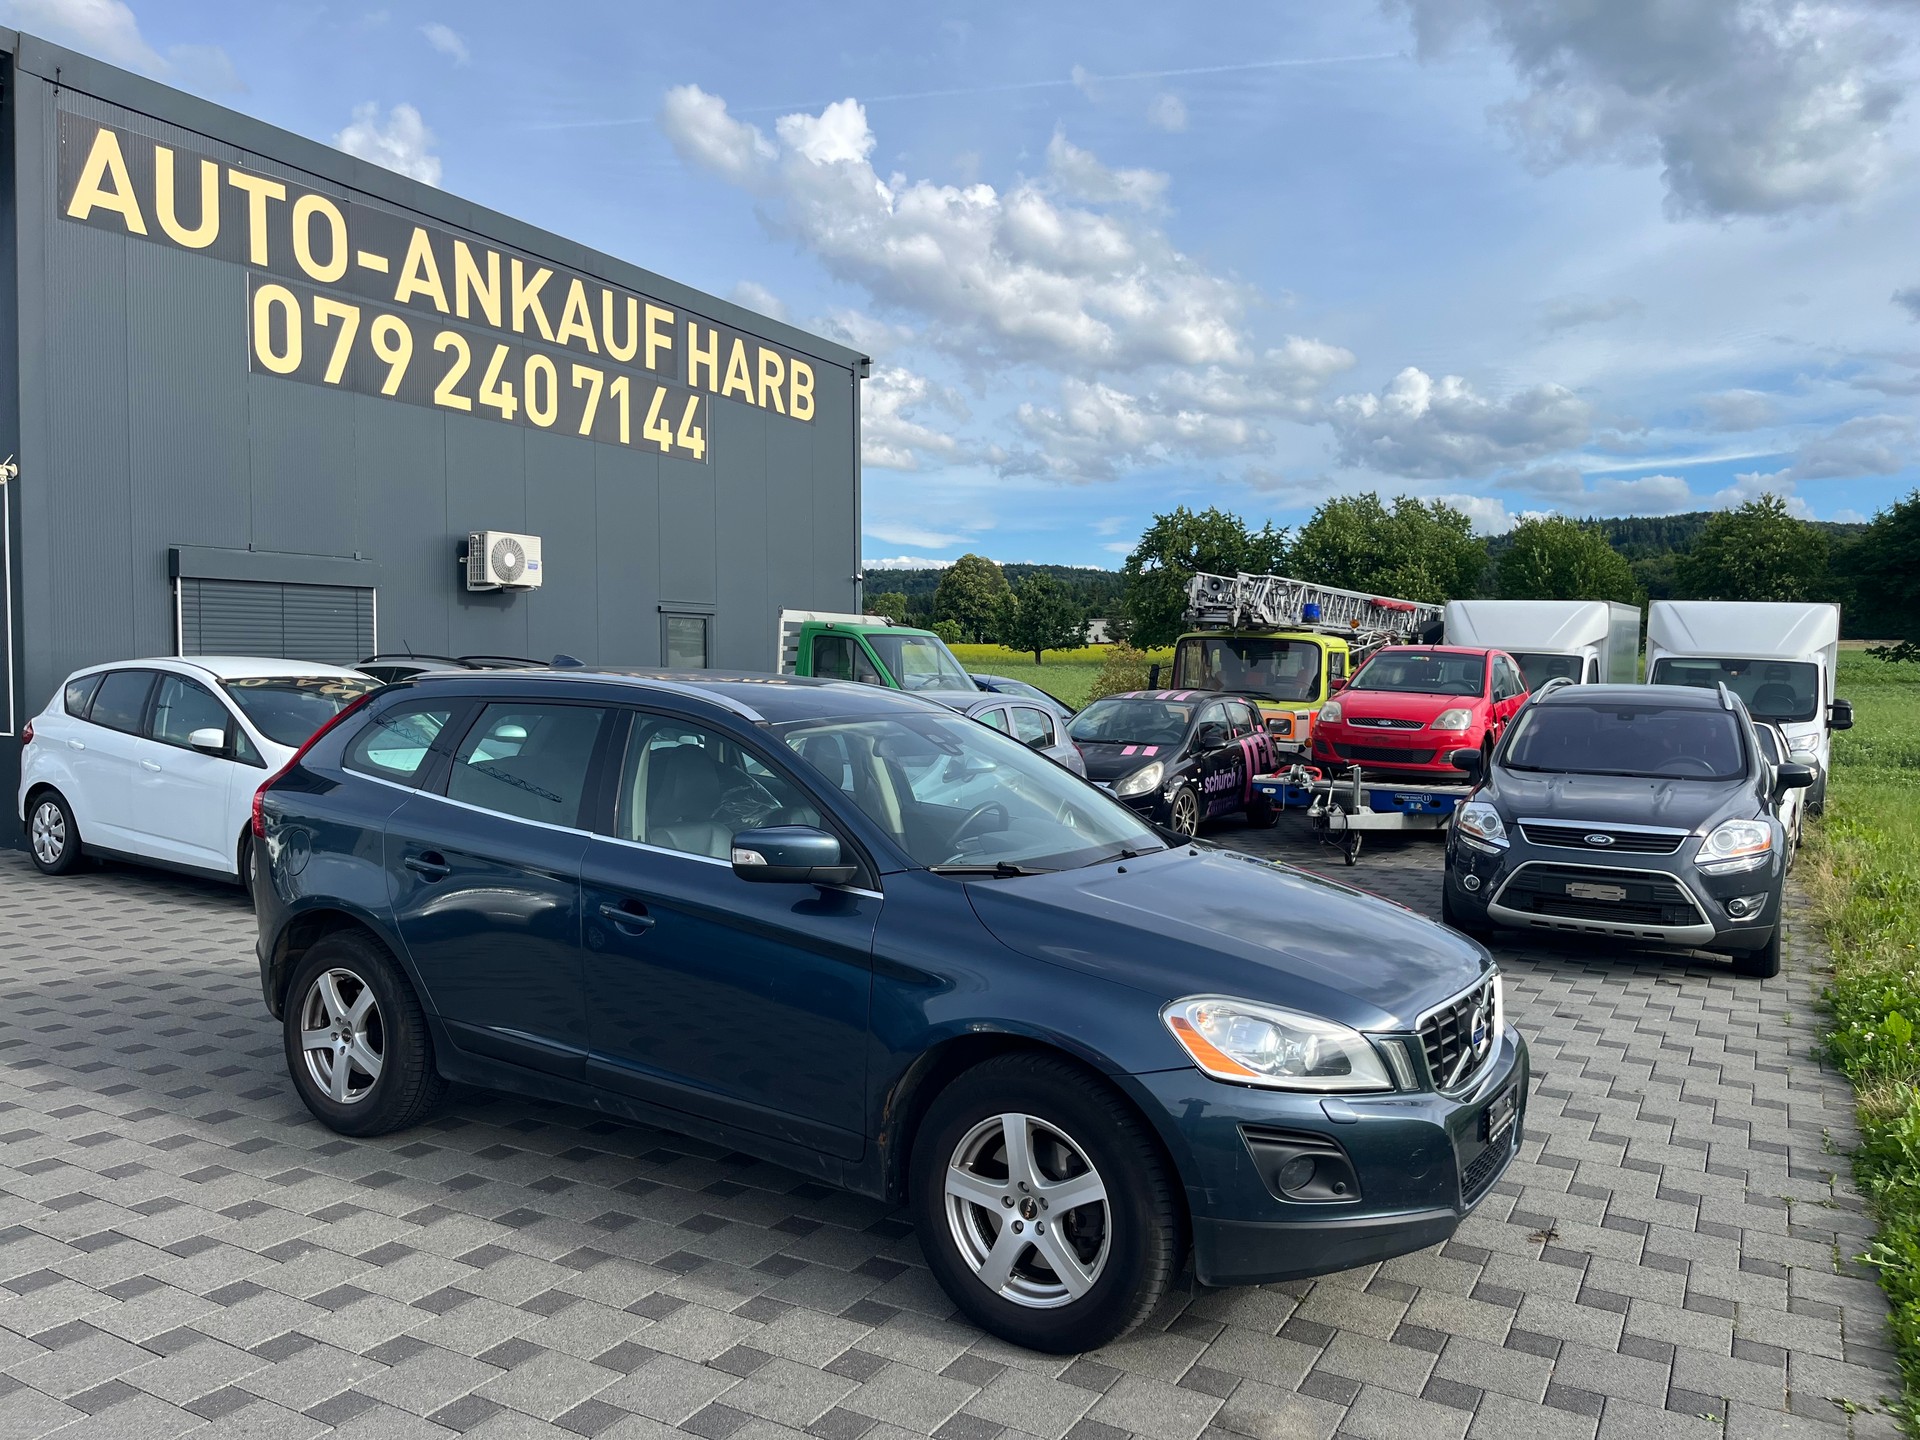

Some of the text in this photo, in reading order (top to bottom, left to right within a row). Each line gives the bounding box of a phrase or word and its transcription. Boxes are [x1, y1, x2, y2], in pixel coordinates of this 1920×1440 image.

[67, 128, 816, 423] AUTO-ANKAUF HARB
[254, 284, 706, 460] 079 240 7144
[1204, 767, 1237, 794] schürch
